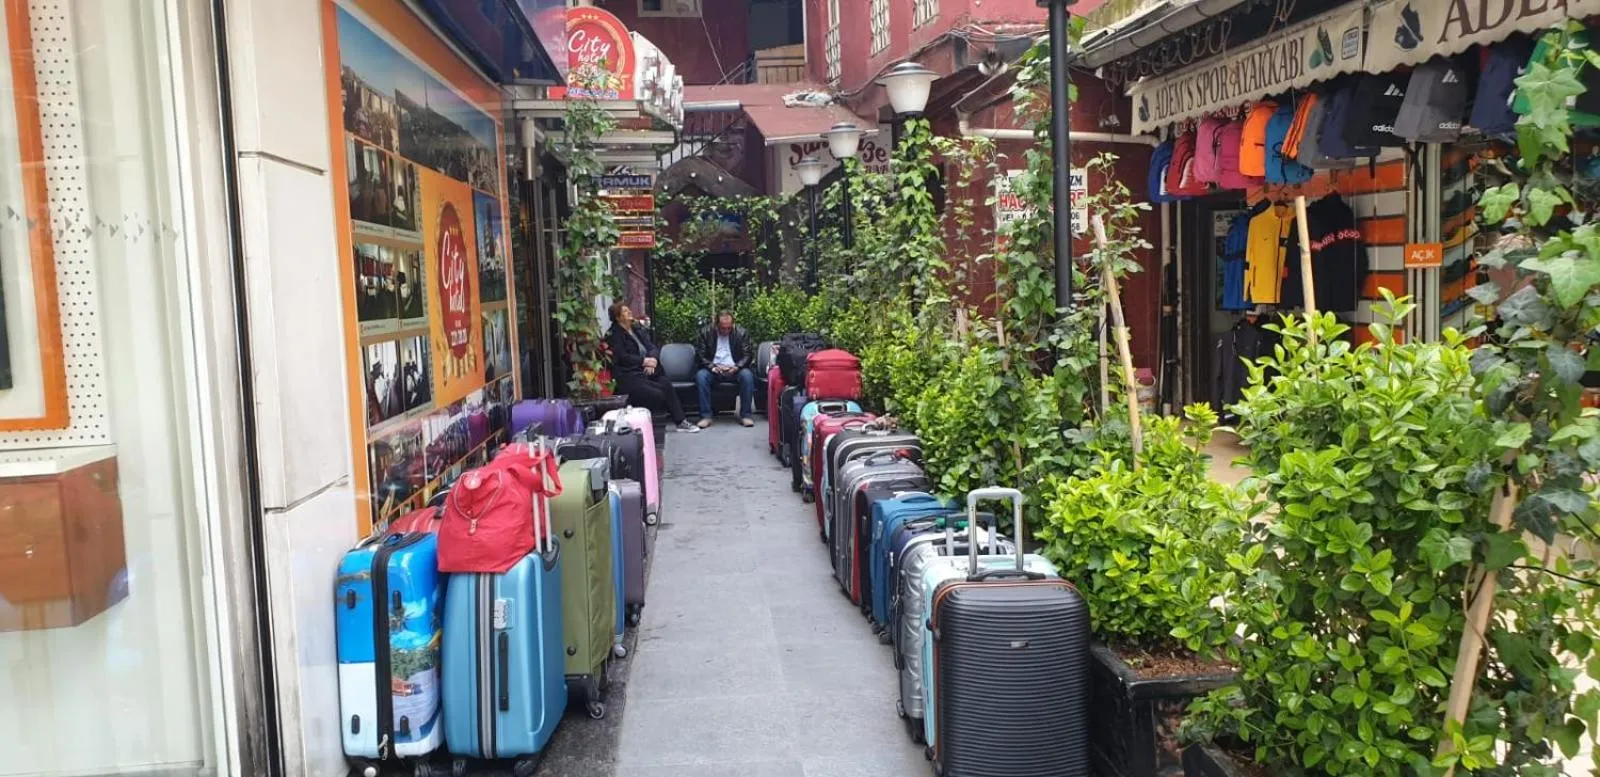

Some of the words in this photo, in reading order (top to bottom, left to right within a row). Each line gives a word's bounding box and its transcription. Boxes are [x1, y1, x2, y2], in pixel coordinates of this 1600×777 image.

[568, 29, 611, 57] City
[577, 49, 605, 63] hote
[1196, 64, 1229, 109] SPOR
[1232, 36, 1305, 97] AYAKKABI
[1372, 122, 1395, 132] adida
[441, 230, 466, 297] City
